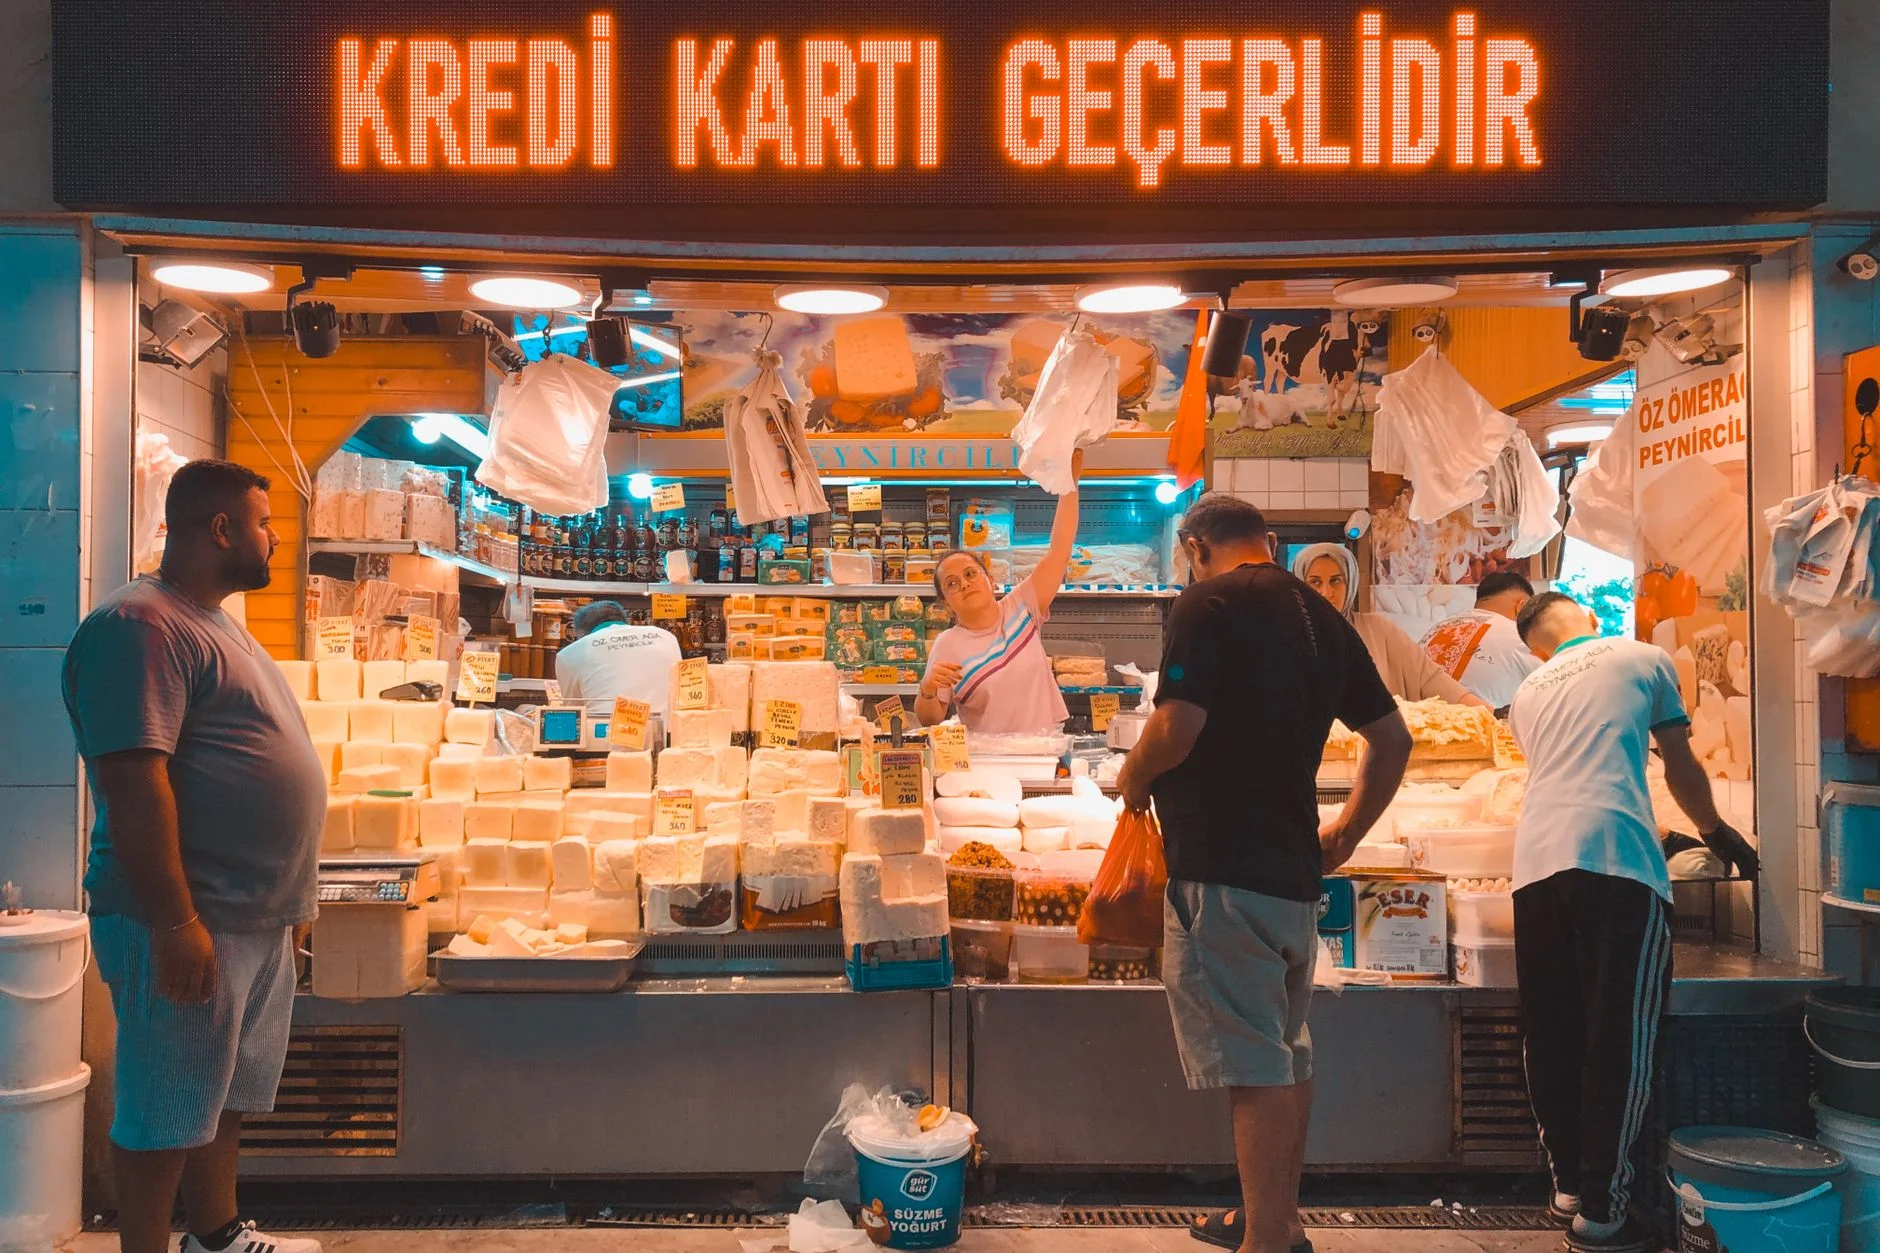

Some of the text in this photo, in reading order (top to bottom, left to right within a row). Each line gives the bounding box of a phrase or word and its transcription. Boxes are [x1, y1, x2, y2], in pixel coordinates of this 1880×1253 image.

[338, 13, 1543, 187] KREDİ KARTI GEÇERLİDİR
[1639, 397, 1664, 433] ÖZ
[769, 735, 786, 745] 320
[898, 794, 918, 804] 280
[1376, 888, 1431, 910] ESER
[894, 1207, 944, 1220] SÜZME
[889, 1219, 947, 1234] YOĞURT
